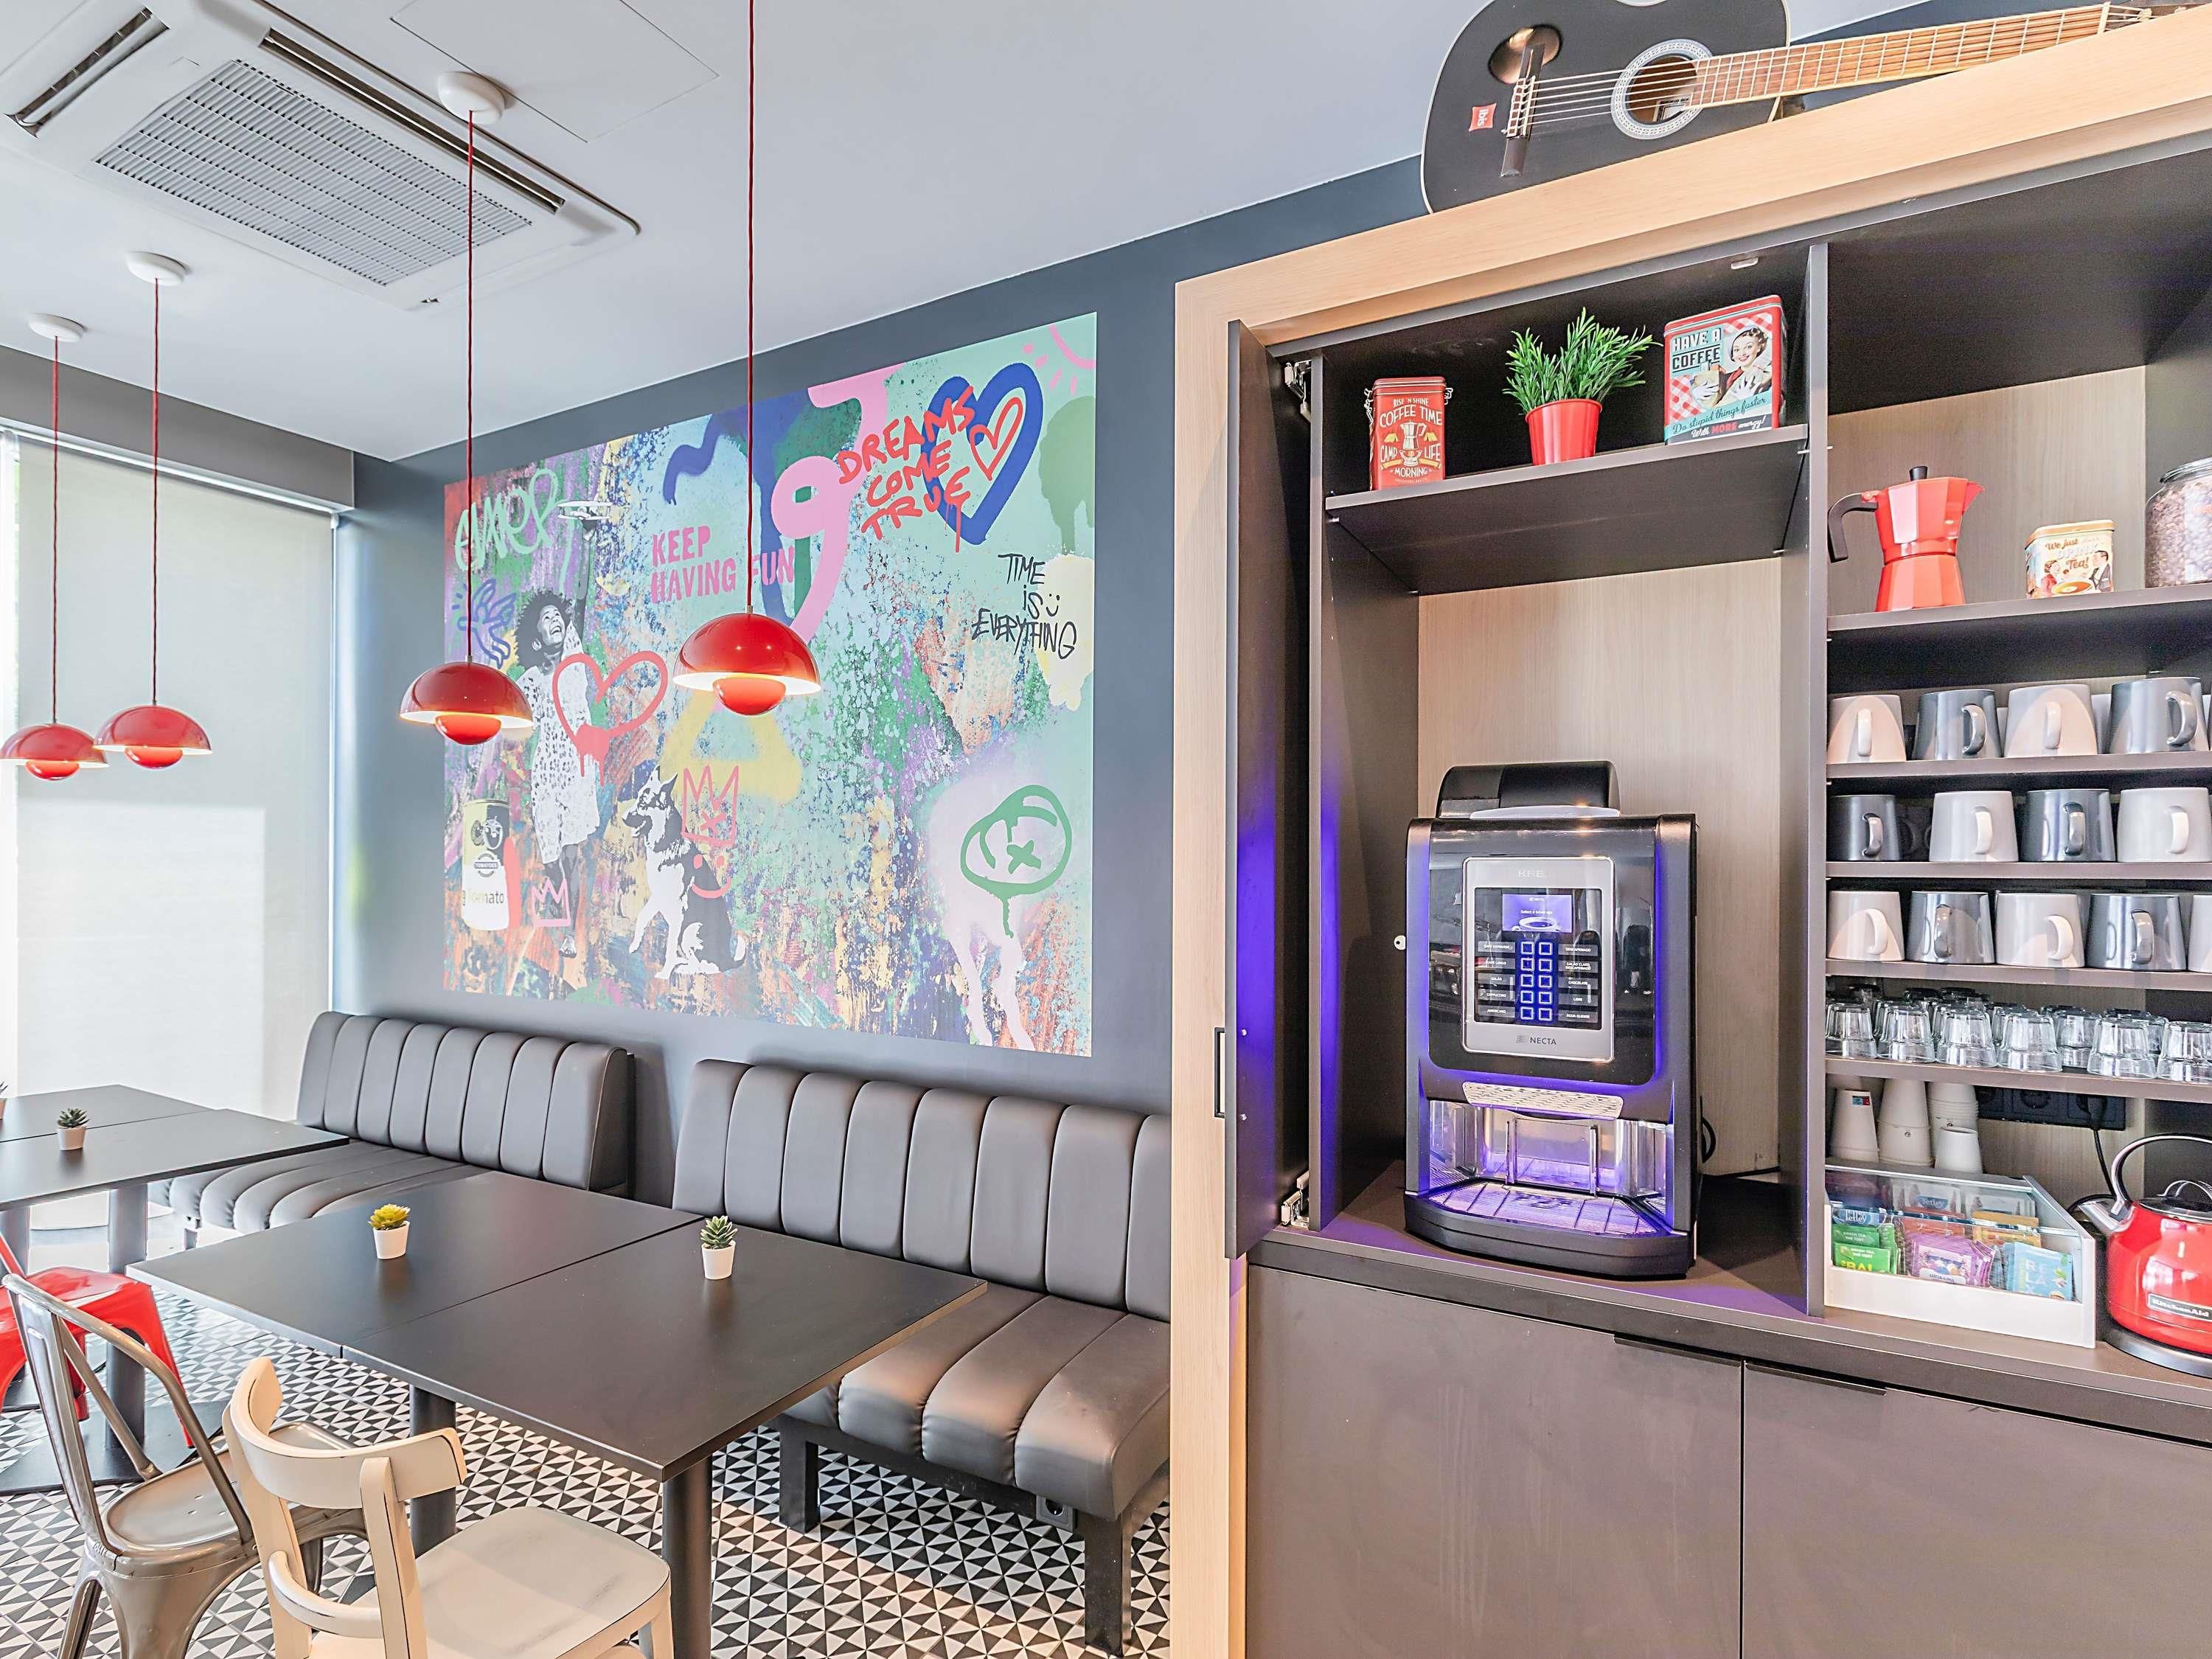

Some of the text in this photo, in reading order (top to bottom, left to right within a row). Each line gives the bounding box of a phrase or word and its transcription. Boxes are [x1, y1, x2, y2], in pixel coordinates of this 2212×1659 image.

[1672, 327, 1722, 352] HAVE A
[1672, 347, 1721, 370] COFFEE
[1393, 398, 1405, 407] RISE
[1413, 397, 1429, 407] SHINE
[1380, 404, 1443, 428] COFFEE TIME
[1672, 422, 1687, 435] Do
[1689, 411, 1715, 429] stupid
[1715, 406, 1740, 420] things
[838, 386, 976, 484] DREAMS
[1691, 427, 1710, 438] With
[1711, 422, 1738, 434] MORE
[1380, 442, 1441, 463] CAMP LIFE
[866, 440, 952, 508] COME
[1394, 467, 1428, 478] MORNING
[861, 466, 971, 540] TRUE
[652, 525, 712, 568] KEEP
[2045, 542, 2061, 550] We
[2062, 538, 2079, 549] just
[650, 546, 795, 604] HAVING FUN
[998, 553, 1045, 585] TIME
[2066, 557, 2089, 570] Tea!
[971, 608, 1077, 659] EVERYTHING
[1530, 1037, 1557, 1045] NECTA
[2152, 1298, 2209, 1317] KitchenAid
